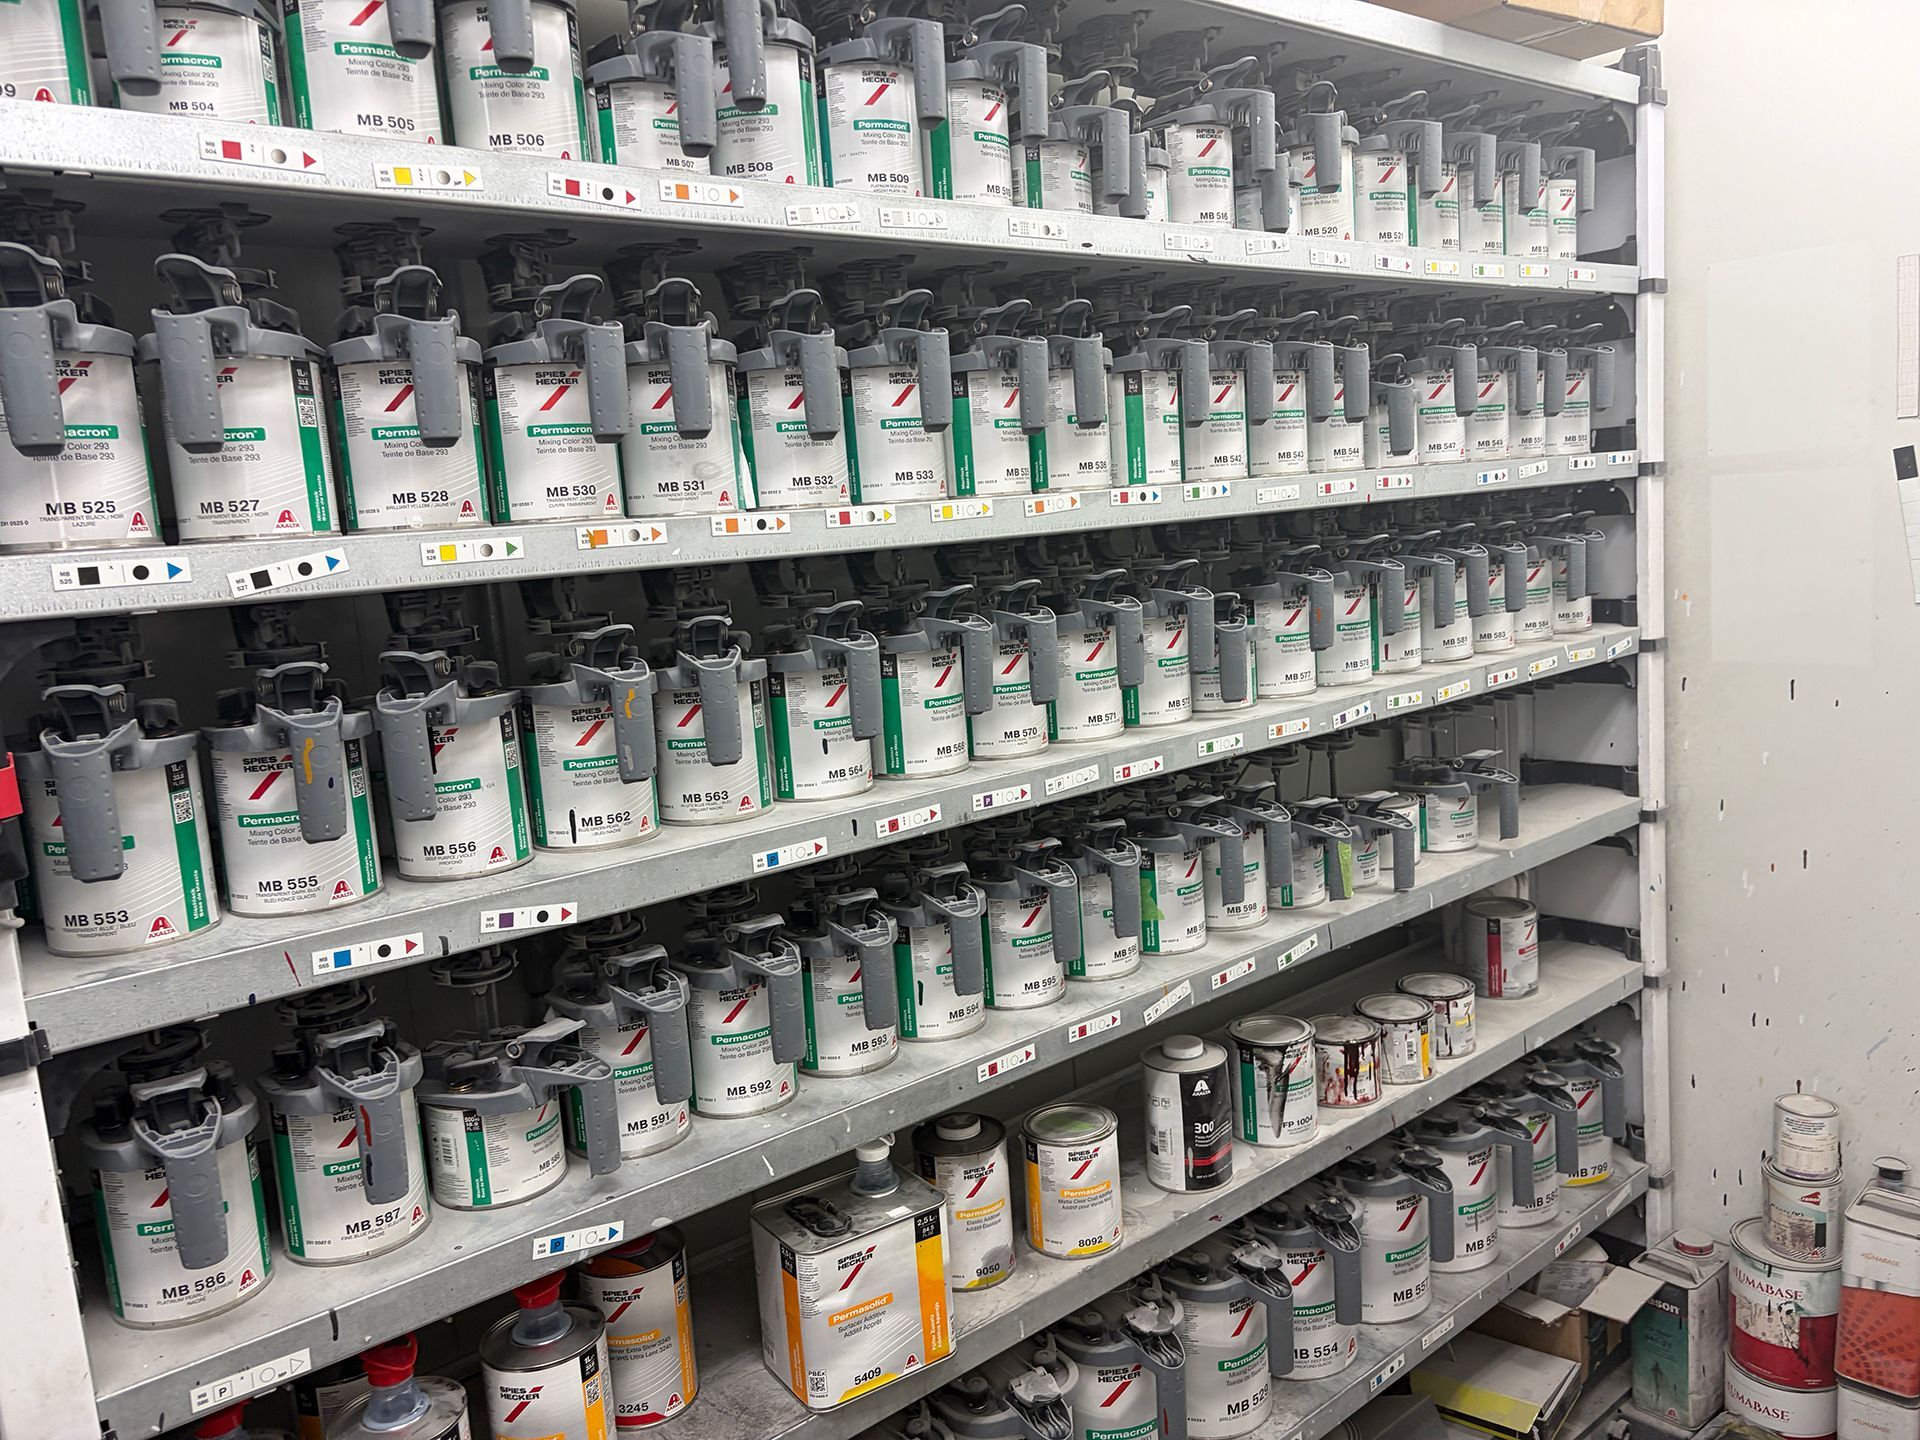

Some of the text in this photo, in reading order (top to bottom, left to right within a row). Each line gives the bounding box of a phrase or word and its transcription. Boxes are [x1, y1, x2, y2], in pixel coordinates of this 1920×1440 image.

[170, 102, 214, 111] MB 504
[357, 114, 415, 131] MB 505
[859, 121, 906, 130] Permacron
[489, 134, 544, 146] MB 506
[667, 158, 694, 169] MB 507
[726, 162, 773, 176] MB 508
[867, 173, 909, 183] MB 509
[1200, 212, 1228, 221] MB 516
[1305, 226, 1337, 236] MB 520
[533, 426, 592, 435] Permacron
[67, 441, 109, 450] Color 293
[384, 441, 408, 449] Mixing
[539, 438, 560, 446] Mixing
[1428, 442, 1456, 451] MB 547
[239, 444, 255, 452] 293
[1333, 448, 1346, 456] MB
[219, 453, 260, 463] Base 293
[1214, 454, 1242, 464] MB 542
[1278, 450, 1304, 460] MB 543
[1079, 461, 1107, 470] MB 536
[792, 475, 833, 486] MB 532
[895, 470, 933, 481] MB 533
[546, 485, 596, 498] MB 530
[658, 480, 705, 493] MB 531
[392, 491, 449, 505] MB 528
[45, 501, 116, 516] MB 525
[200, 499, 259, 514] MB 527
[1084, 636, 1110, 644] HECKER
[1494, 631, 1506, 639] 583
[1457, 637, 1468, 645] 581
[1285, 671, 1311, 681] MB 577
[571, 707, 602, 716] SPIES
[572, 713, 614, 723] HECKER
[1088, 712, 1117, 724] MB 571
[1004, 727, 1038, 740] MB 570
[242, 756, 277, 765] SPIES
[243, 762, 293, 773] HECKER
[829, 764, 863, 779] MB 564
[682, 790, 729, 804] MB 563
[443, 803, 462, 811] Base
[581, 811, 631, 828] MB 562
[249, 827, 296, 836] Mixing Color
[423, 841, 476, 857] MB 556
[258, 876, 318, 893] MB 555
[1227, 903, 1257, 915] MB 598
[64, 910, 129, 927] MB 553
[1024, 975, 1056, 992] MB 595
[949, 1003, 979, 1021] MB 594
[716, 1028, 770, 1044] Permacron
[851, 1034, 887, 1053] MB 593
[727, 1080, 772, 1097] MB 592
[627, 1111, 670, 1132] MB 591
[1195, 1120, 1214, 1134] 300
[1282, 1120, 1295, 1129] FP
[1068, 1149, 1090, 1158] SPIES
[1068, 1152, 1099, 1162] HECKER
[963, 1166, 986, 1175] SPIES
[963, 1169, 994, 1180] HECKER
[1568, 1162, 1608, 1178] MB 799
[1064, 1183, 1108, 1197] Permasolid
[959, 1200, 1003, 1219] Permasolid
[345, 1207, 400, 1237] MB 587
[1078, 1236, 1104, 1248] 8092
[838, 1251, 863, 1264] SPIES
[838, 1253, 873, 1270] HECKER
[1287, 1255, 1325, 1264] HECKER
[976, 1263, 1000, 1277] 9050
[162, 1272, 226, 1300] MB 586
[602, 1289, 628, 1297] SPIES
[602, 1294, 641, 1302] HECKER
[833, 1296, 887, 1323] Permasolid
[838, 1309, 886, 1333] Surfacer Additive
[1314, 1342, 1338, 1357] 554
[854, 1367, 882, 1386] 5409
[1097, 1367, 1129, 1376] SPIES
[1098, 1371, 1141, 1383] HECKER
[219, 1387, 227, 1397] P
[500, 1392, 539, 1400] HECKER
[1227, 1384, 1269, 1416] MB 529
[619, 1402, 649, 1413] 3245
[1091, 1423, 1155, 1440] Permacron
